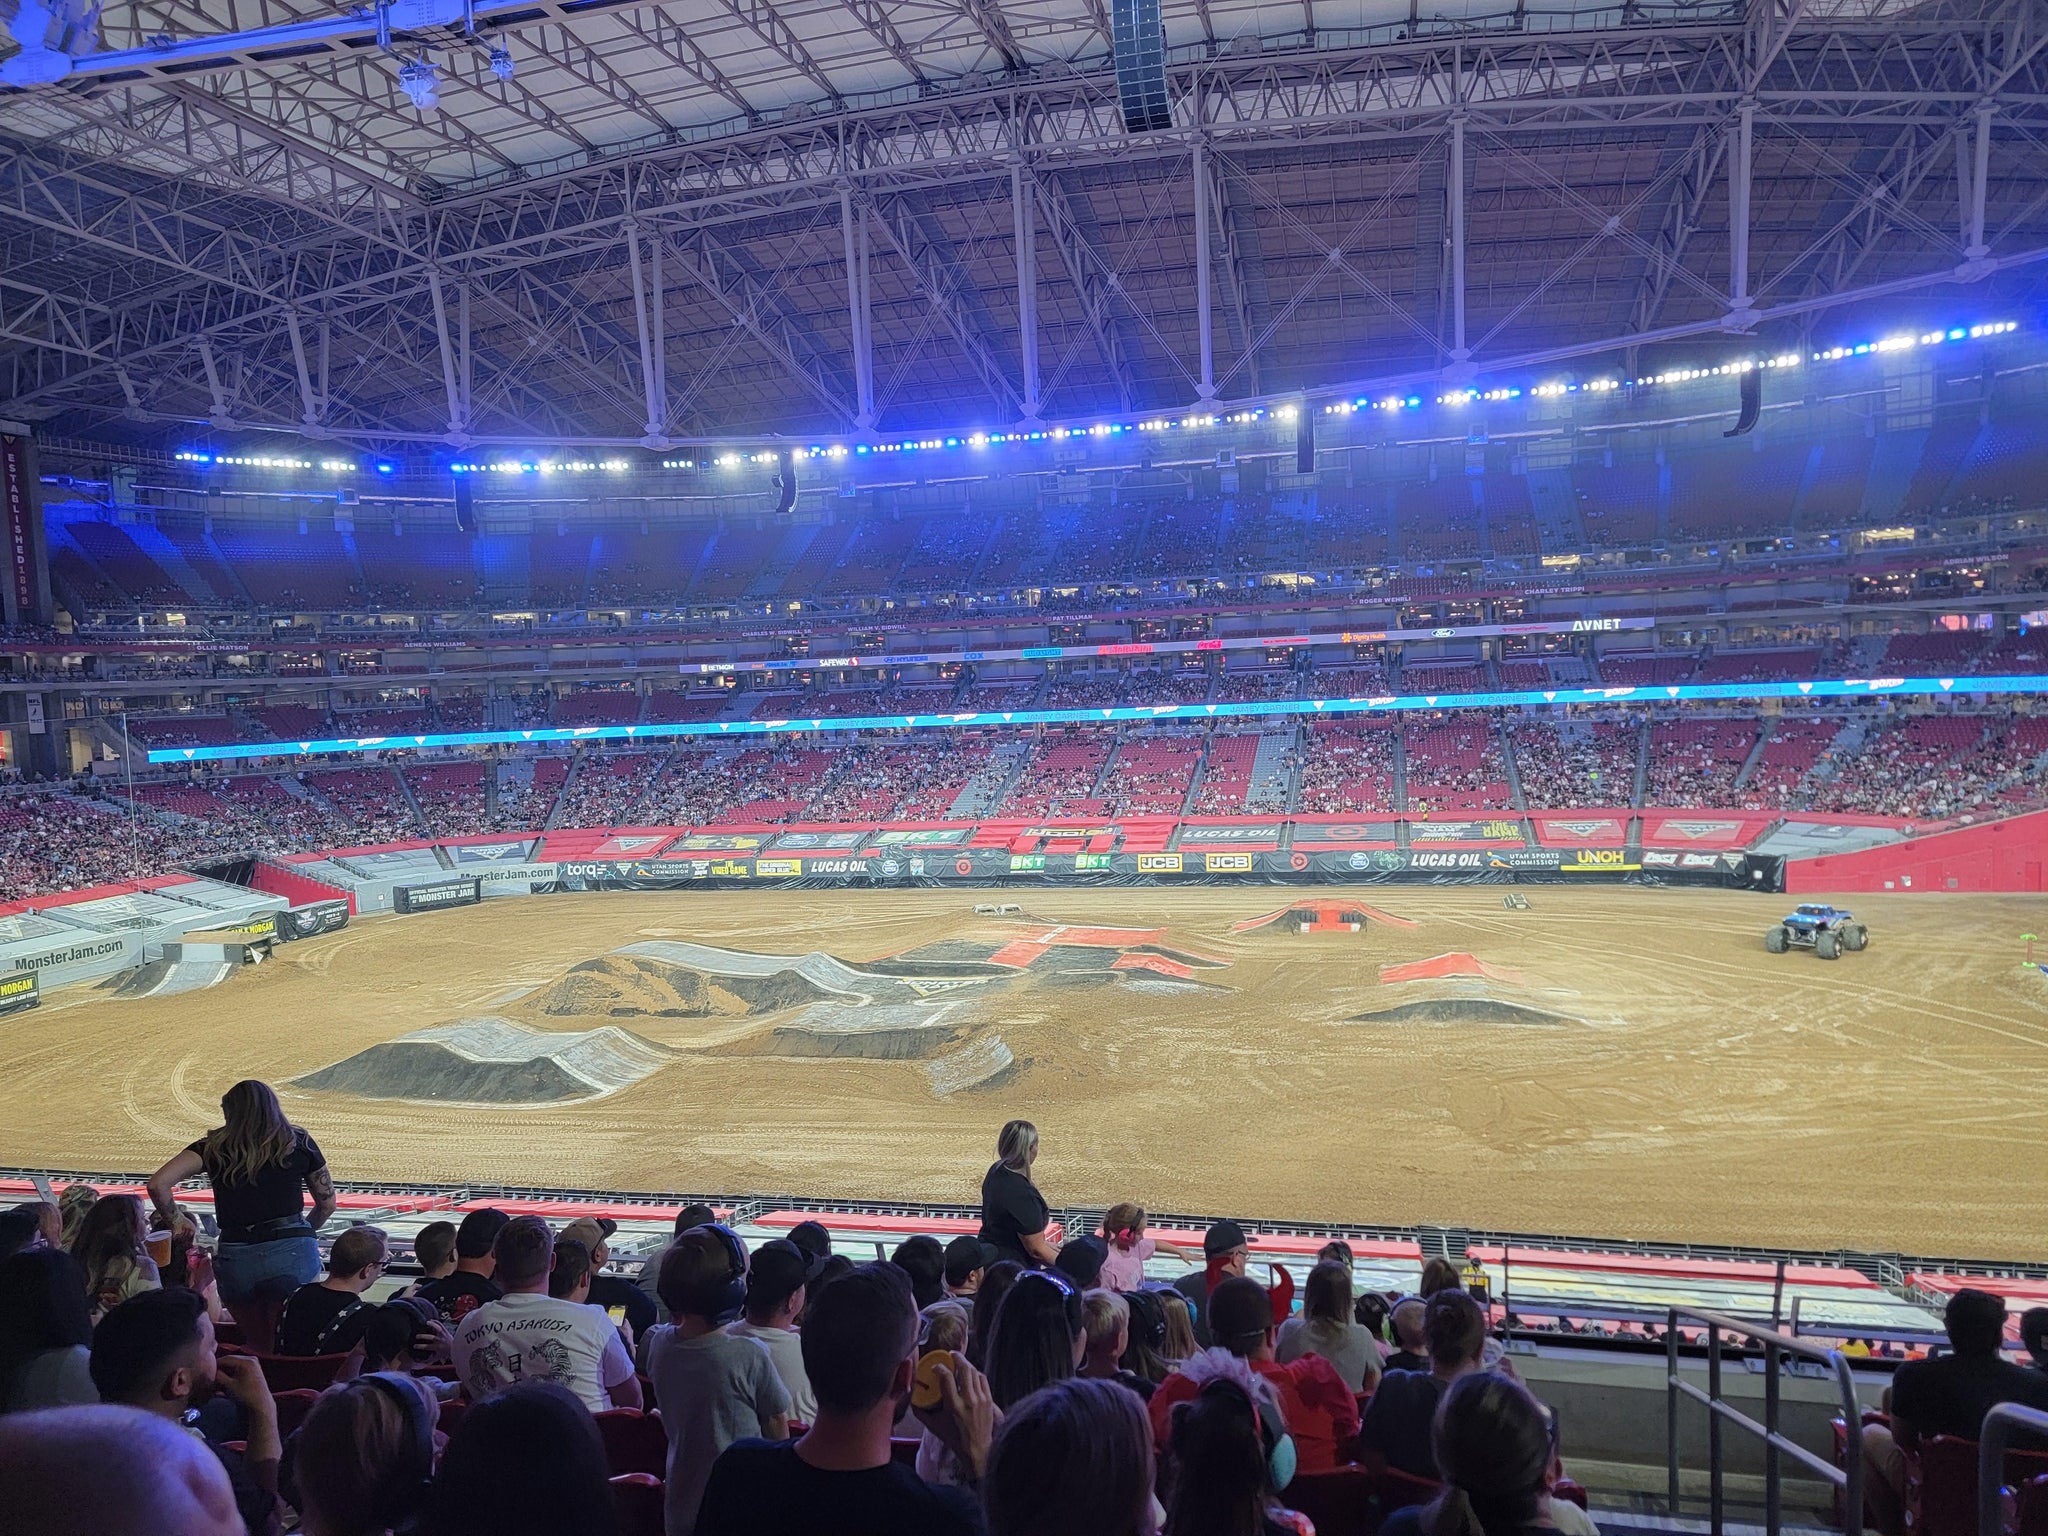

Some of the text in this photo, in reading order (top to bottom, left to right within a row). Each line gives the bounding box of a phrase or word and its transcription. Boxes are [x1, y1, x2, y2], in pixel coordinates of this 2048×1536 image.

[8, 453, 25, 564] ESTABLISHED
[18, 565, 28, 606] 1898
[1572, 618, 1621, 631] AVNET
[819, 658, 850, 667] SAFEWAY
[1183, 830, 1242, 838] LUCAS
[1010, 855, 1045, 869] BKT
[1075, 855, 1110, 868] BKT
[1141, 857, 1179, 869] JCB
[1210, 856, 1248, 868] JCB
[1411, 854, 1453, 866] LUCAS
[1577, 850, 1625, 863] UNOH
[811, 861, 848, 872] LUCAS
[418, 887, 475, 903] MONSTER JAM
[15, 940, 123, 970] MonsterJam.com
[0, 978, 33, 996] MORGAN
[464, 1318, 573, 1345] TOKYO ASAKUSA
